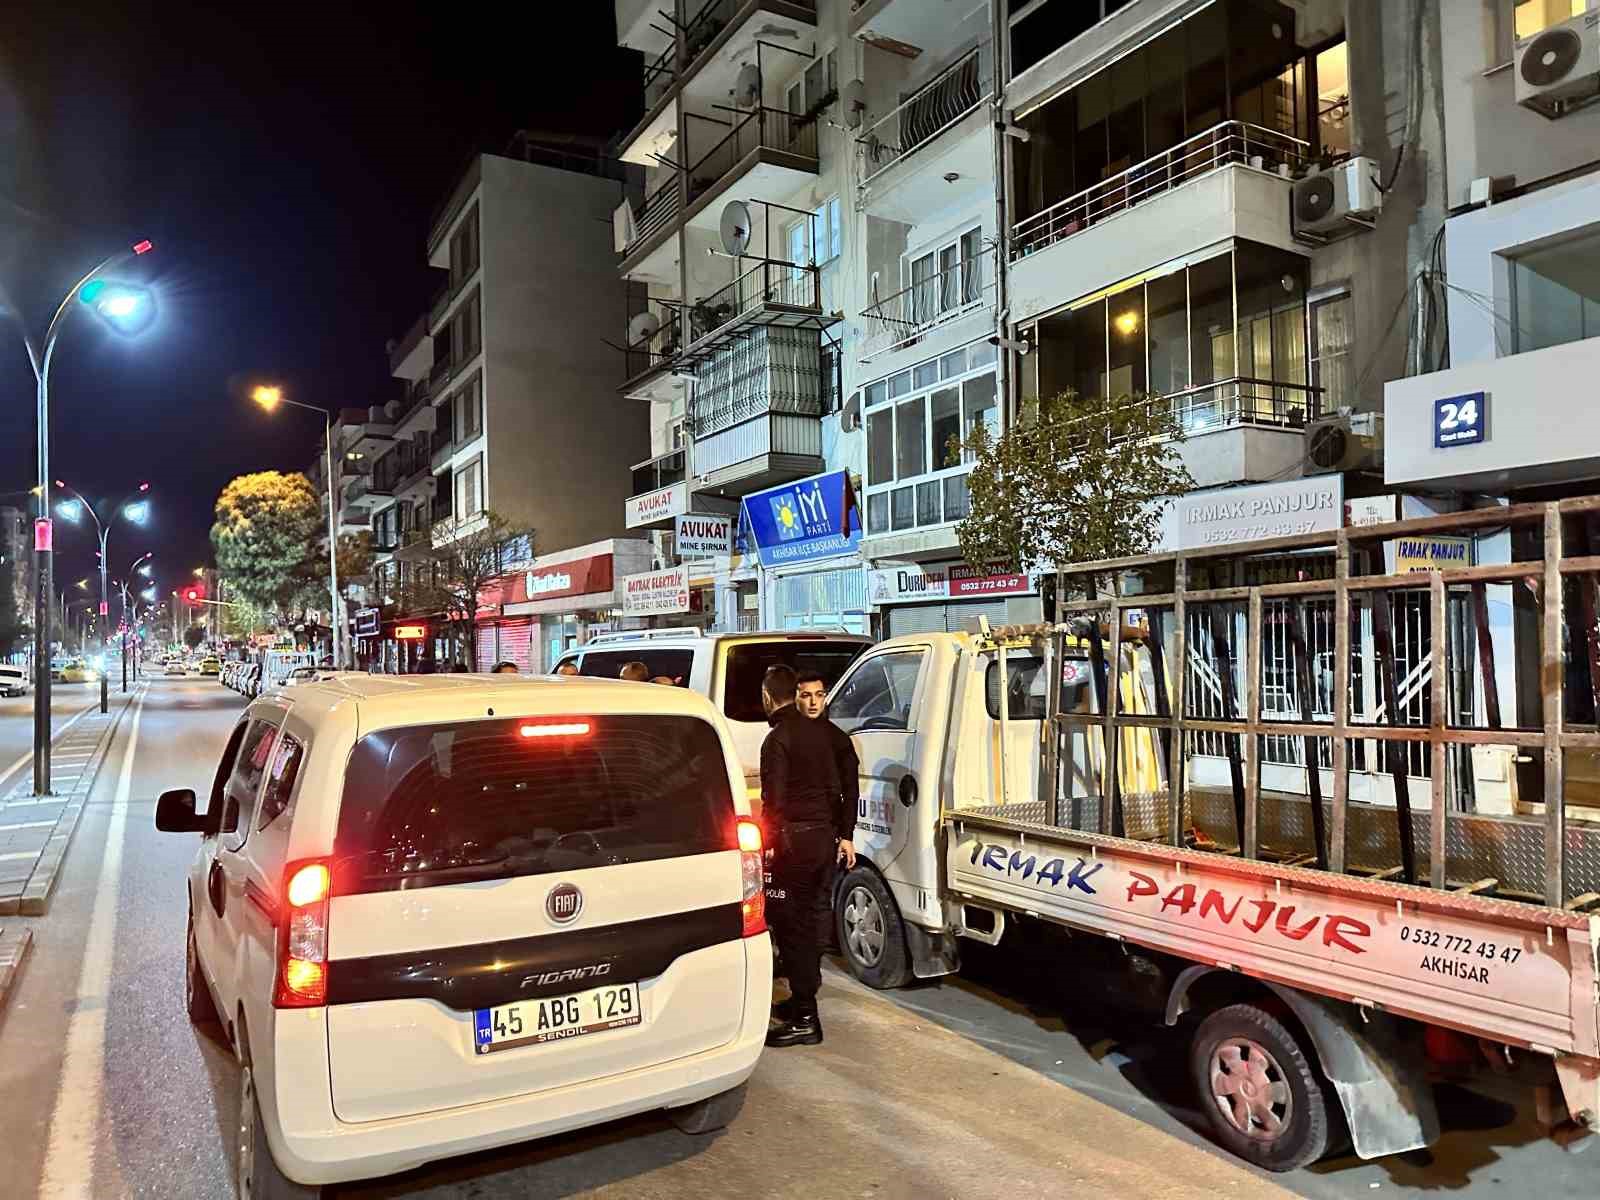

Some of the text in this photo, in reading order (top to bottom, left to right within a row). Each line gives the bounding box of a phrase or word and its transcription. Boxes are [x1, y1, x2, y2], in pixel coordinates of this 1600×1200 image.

[1440, 400, 1478, 429] 24
[638, 491, 673, 513] AVUKAT
[795, 481, 828, 524] İYİ
[1185, 501, 1245, 525] IRMAK
[1250, 489, 1334, 517] PANJUR
[680, 521, 729, 540] AVUKAT
[1201, 529, 1239, 543] 0532
[1239, 525, 1268, 540] 772
[1272, 522, 1292, 536] 43
[1398, 540, 1465, 561] IRMAK PANJUR
[555, 893, 576, 913] FIAT
[970, 841, 1371, 954] IRMAK PANJUR
[1400, 925, 1522, 964] 0 532 772 43 47
[520, 962, 611, 989] FIORINO
[1419, 955, 1489, 985] AKHİSAR
[493, 986, 633, 1037] 45 ABG 129
[479, 1027, 491, 1039] TR
